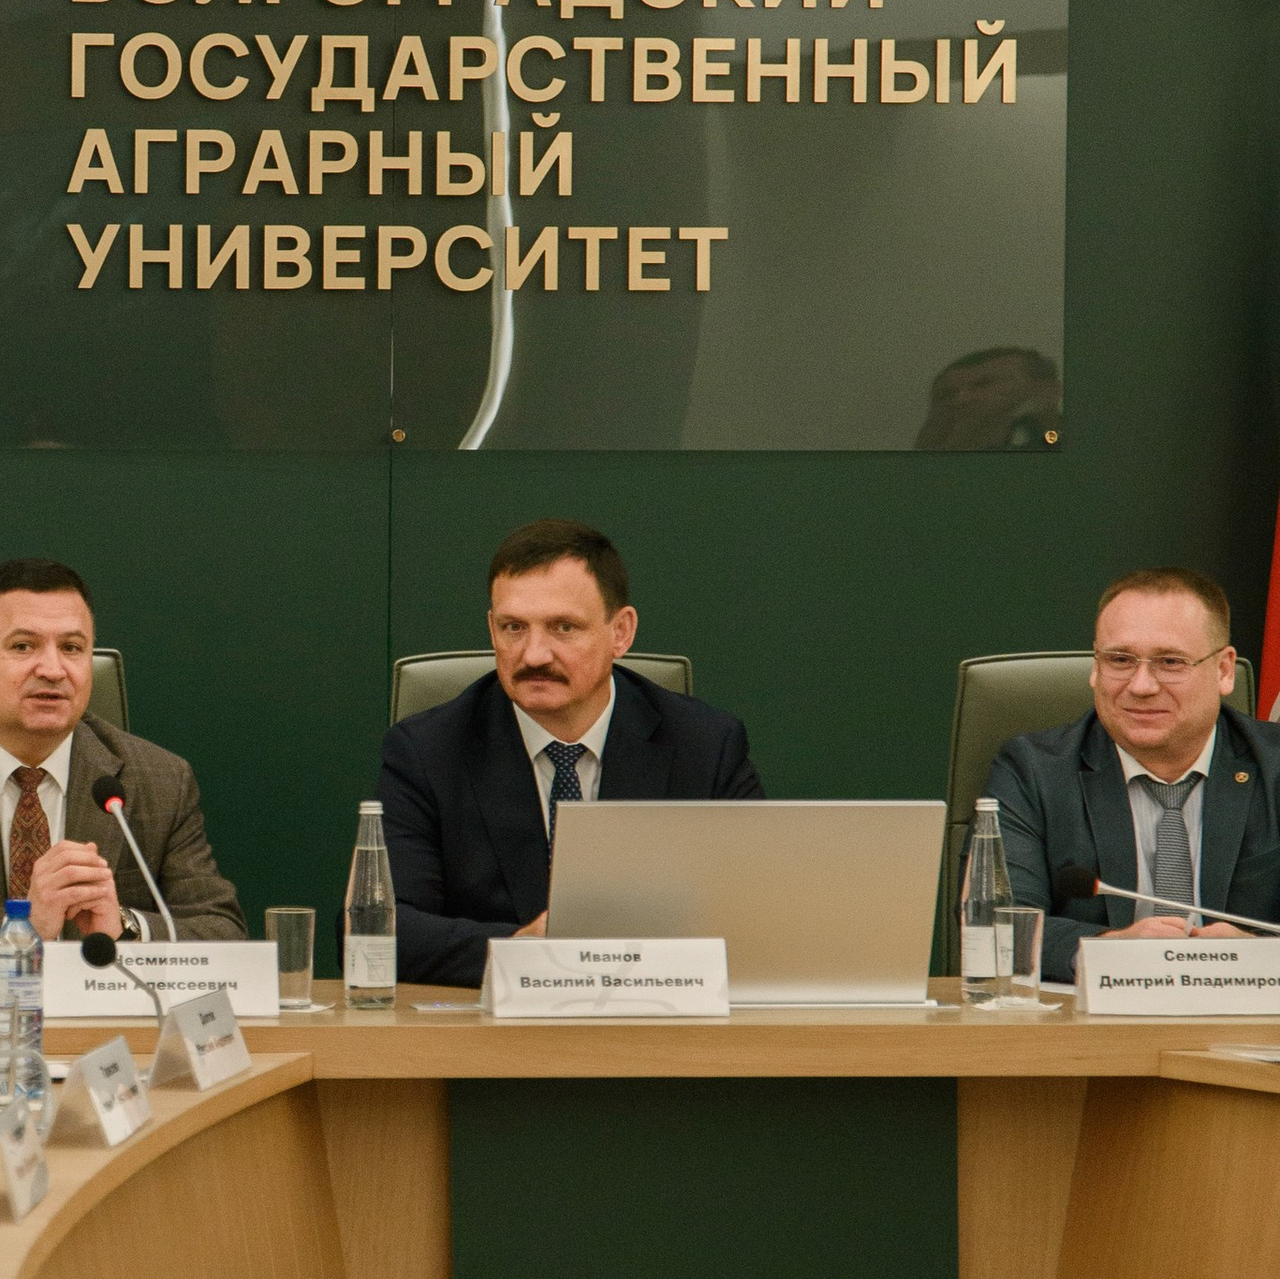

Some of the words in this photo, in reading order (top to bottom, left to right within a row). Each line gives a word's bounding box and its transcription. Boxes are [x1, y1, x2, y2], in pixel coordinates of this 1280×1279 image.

[71, 20, 1017, 113] ГОСУДАРСТВЕННЫЙ
[68, 112, 573, 197] АГРАРНЫЙ
[67, 224, 729, 292] УНИВЕРСИТЕТ
[579, 951, 642, 963] Иванов
[1164, 949, 1239, 962] Семенов
[84, 979, 128, 991] Иван
[520, 975, 596, 989] Василий
[601, 974, 704, 988] Васильевич
[1099, 974, 1175, 990] Дмитрий
[1180, 974, 1280, 990] Владимиро
